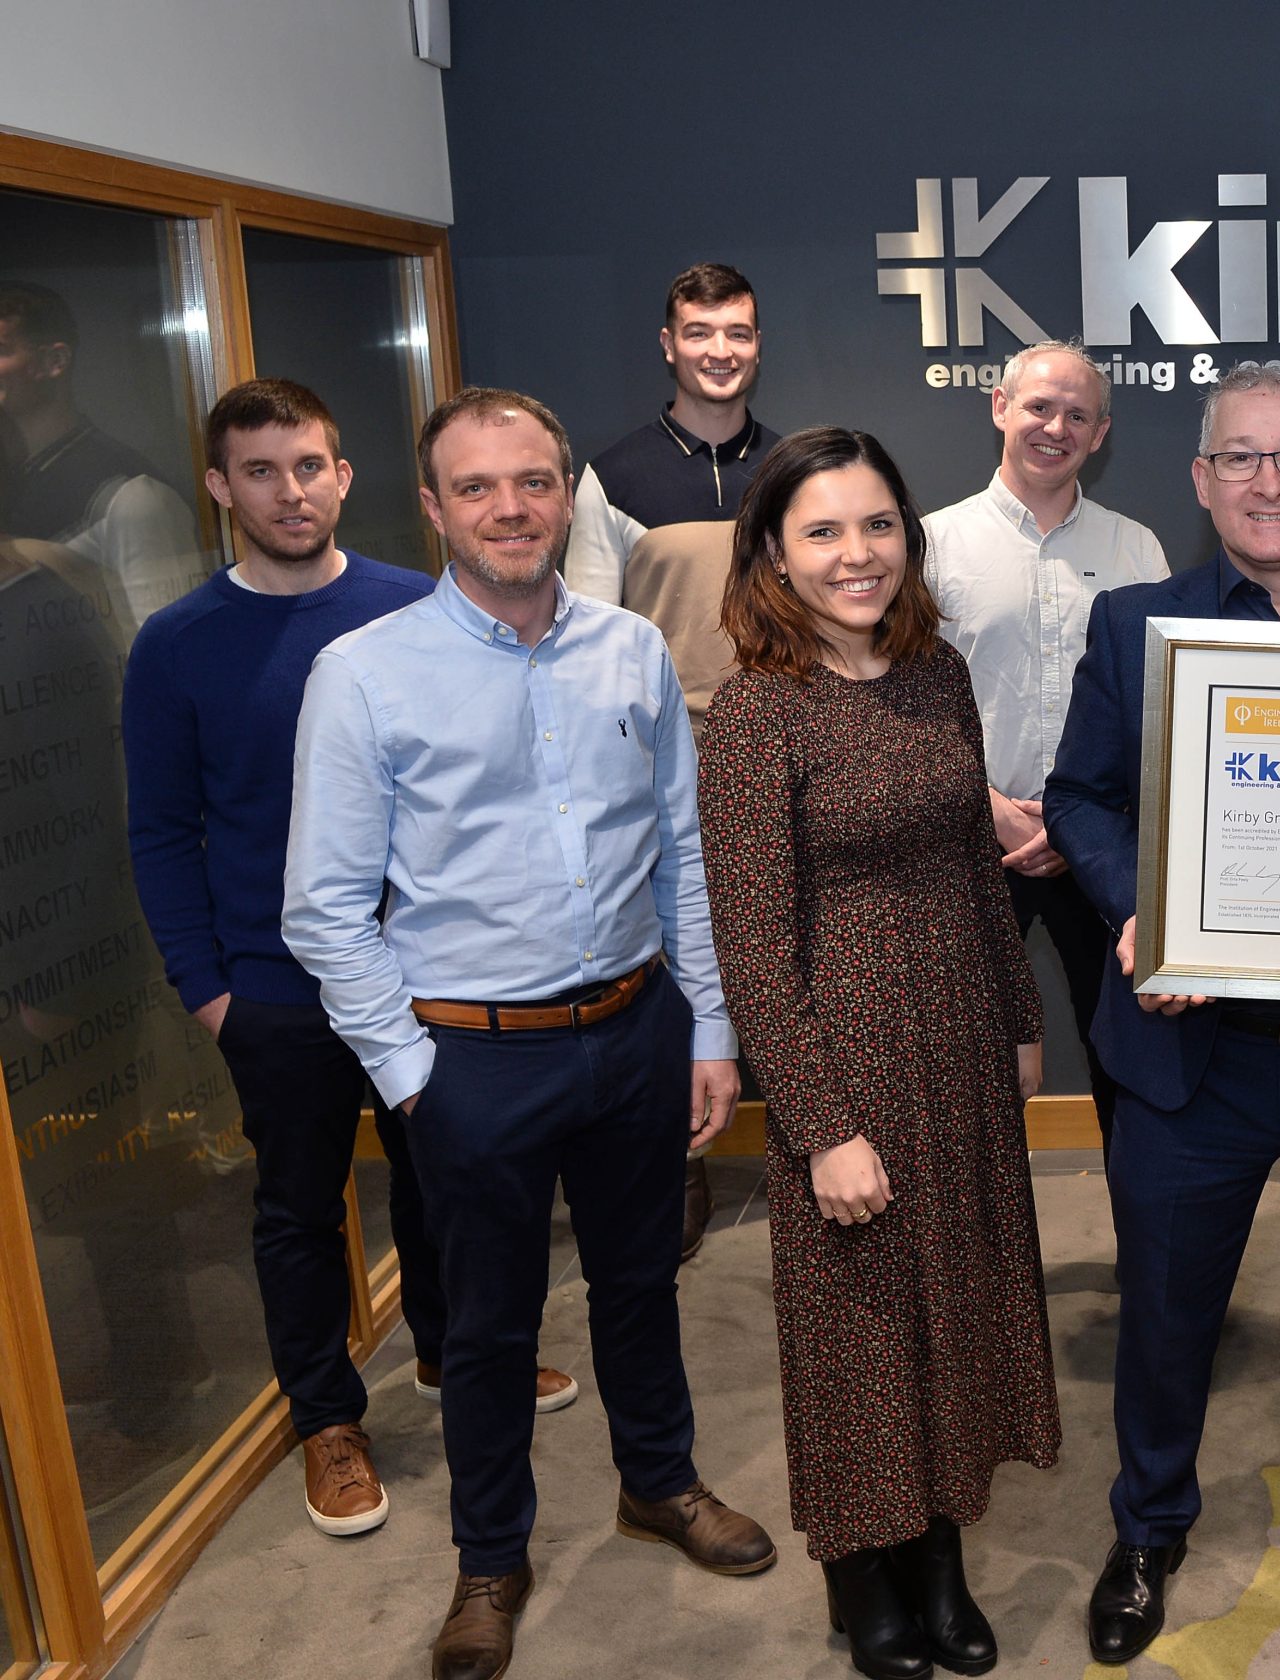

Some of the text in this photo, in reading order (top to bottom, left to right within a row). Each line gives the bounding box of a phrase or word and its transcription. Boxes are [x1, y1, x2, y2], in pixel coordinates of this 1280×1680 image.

[1190, 354, 1219, 384] &
[1231, 782, 1274, 790] engineering
[1223, 810, 1260, 826] Kirby
